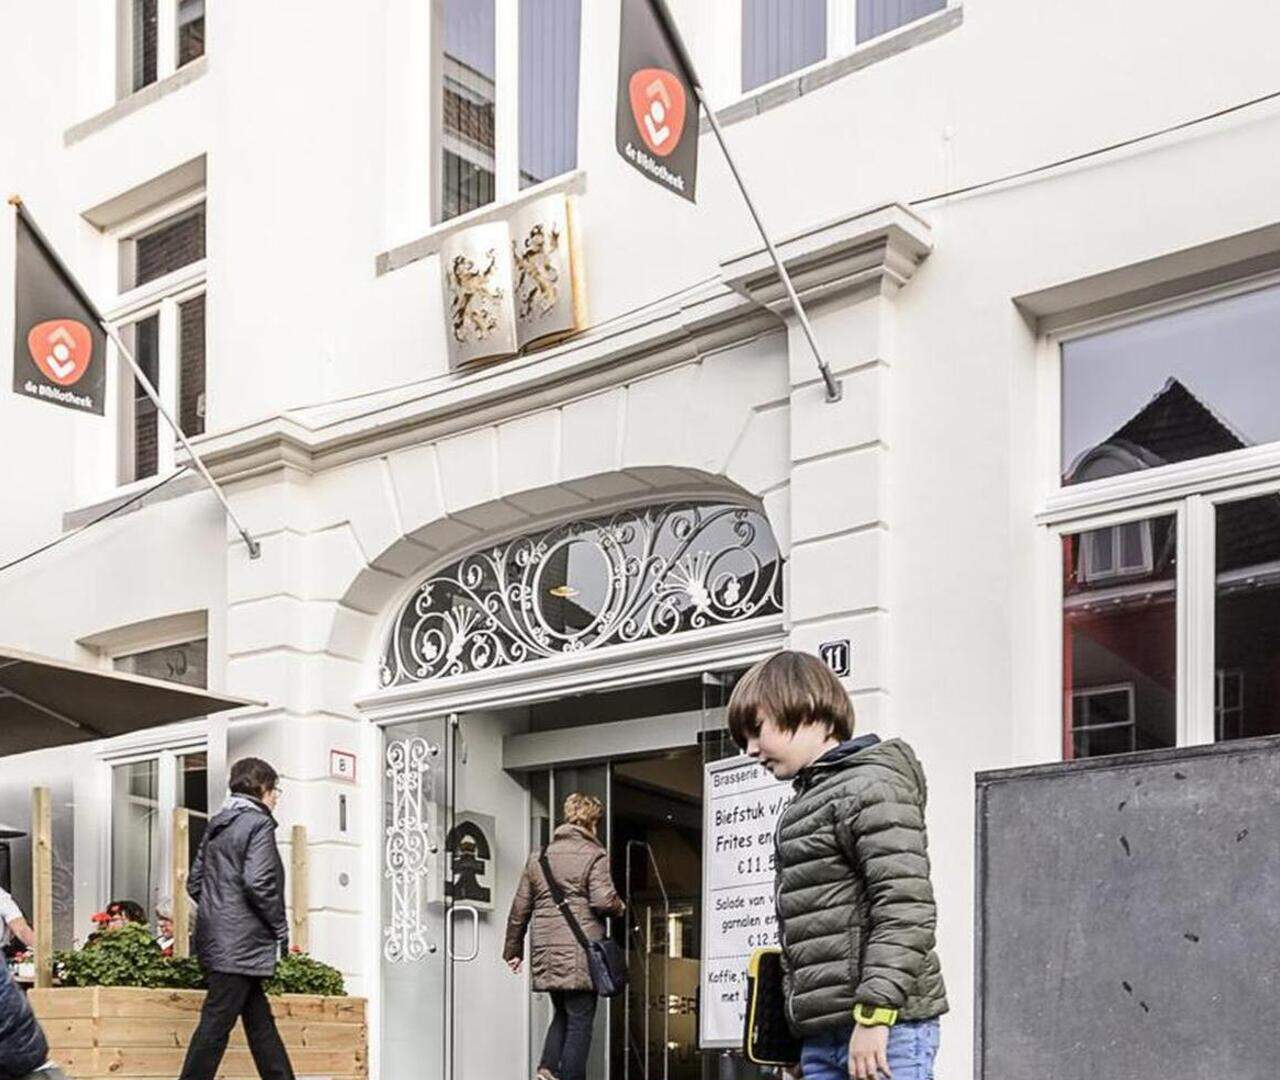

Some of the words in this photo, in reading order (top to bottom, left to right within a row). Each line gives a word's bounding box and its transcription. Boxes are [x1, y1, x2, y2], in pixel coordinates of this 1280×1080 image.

[826, 646, 842, 671] 11
[714, 768, 758, 788] Brasserie
[715, 801, 765, 827] Biefstuk
[715, 834, 752, 853] Frites
[758, 831, 772, 845] en
[749, 896, 765, 906] van
[721, 914, 761, 933] garnalen
[721, 991, 739, 1002] met
